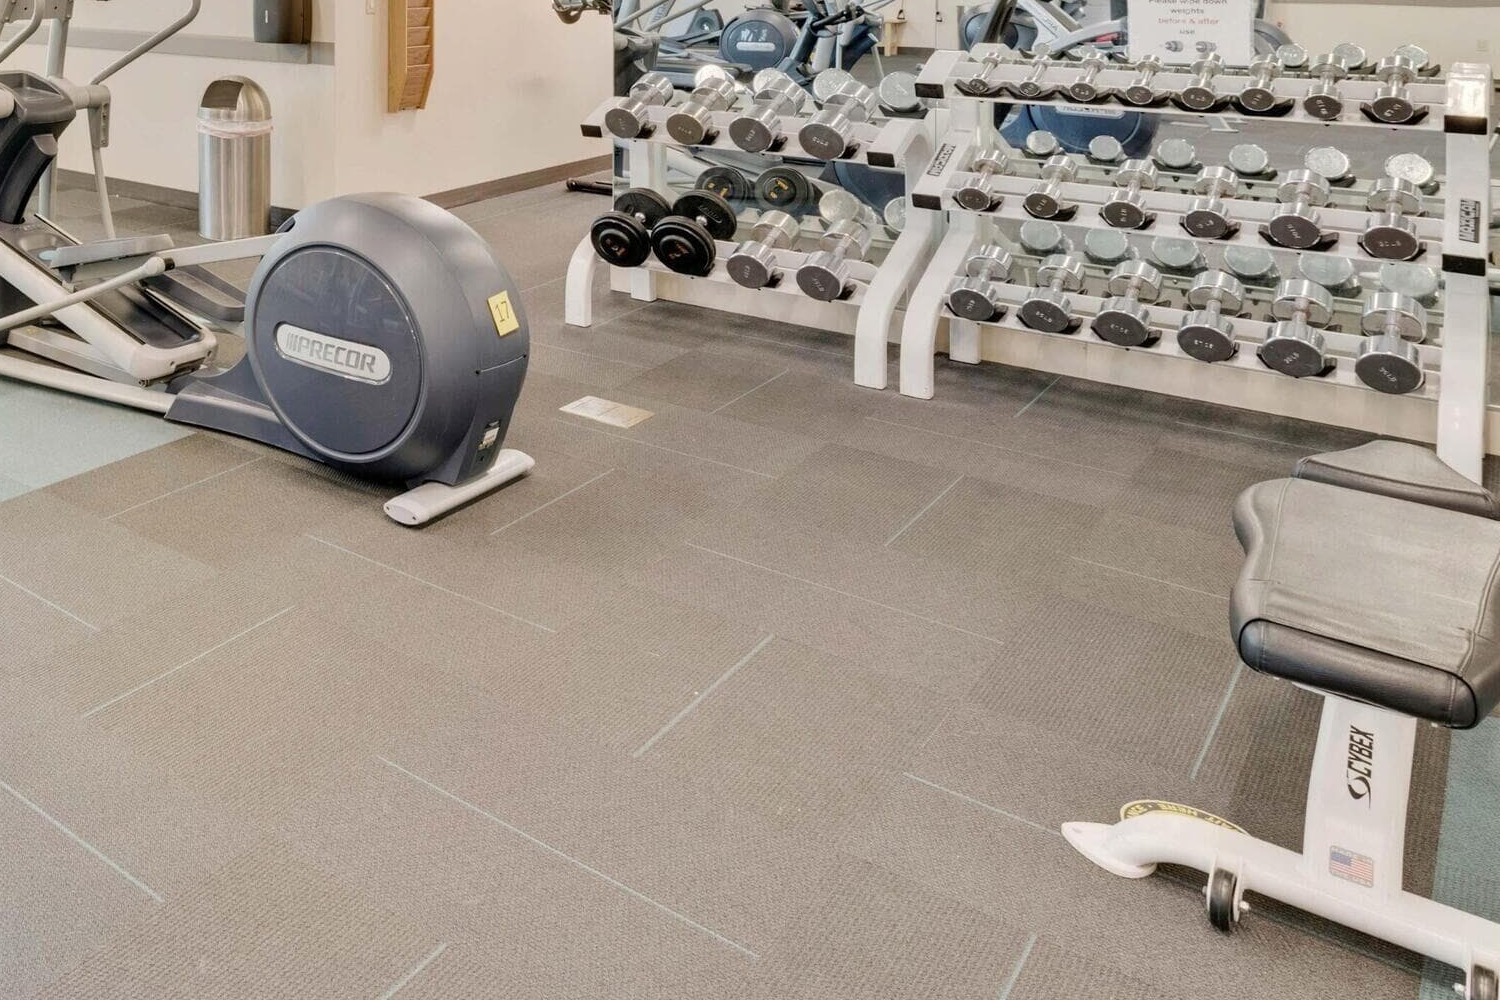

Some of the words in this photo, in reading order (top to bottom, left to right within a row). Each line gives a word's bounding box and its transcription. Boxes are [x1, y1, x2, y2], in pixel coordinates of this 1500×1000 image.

[1170, 7, 1205, 15] weights
[494, 300, 510, 323] 17
[297, 335, 376, 374] PRECOR
[1347, 725, 1374, 779] CYBEX
